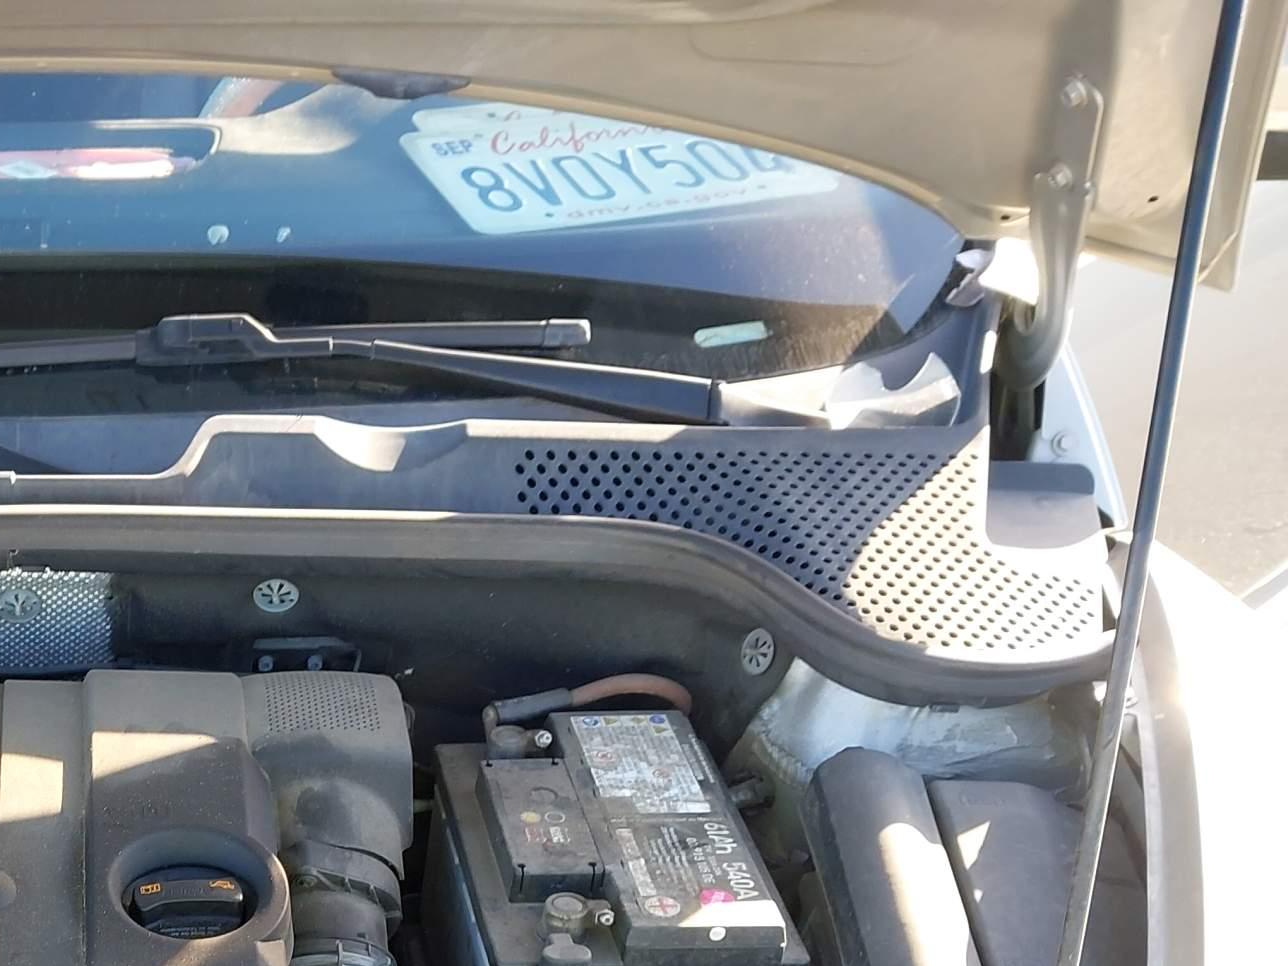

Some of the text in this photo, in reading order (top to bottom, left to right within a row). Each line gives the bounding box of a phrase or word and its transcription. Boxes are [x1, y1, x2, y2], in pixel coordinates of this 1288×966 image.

[490, 121, 649, 155] Californ
[703, 822, 738, 855] 61Ah
[722, 862, 760, 901] 540A
